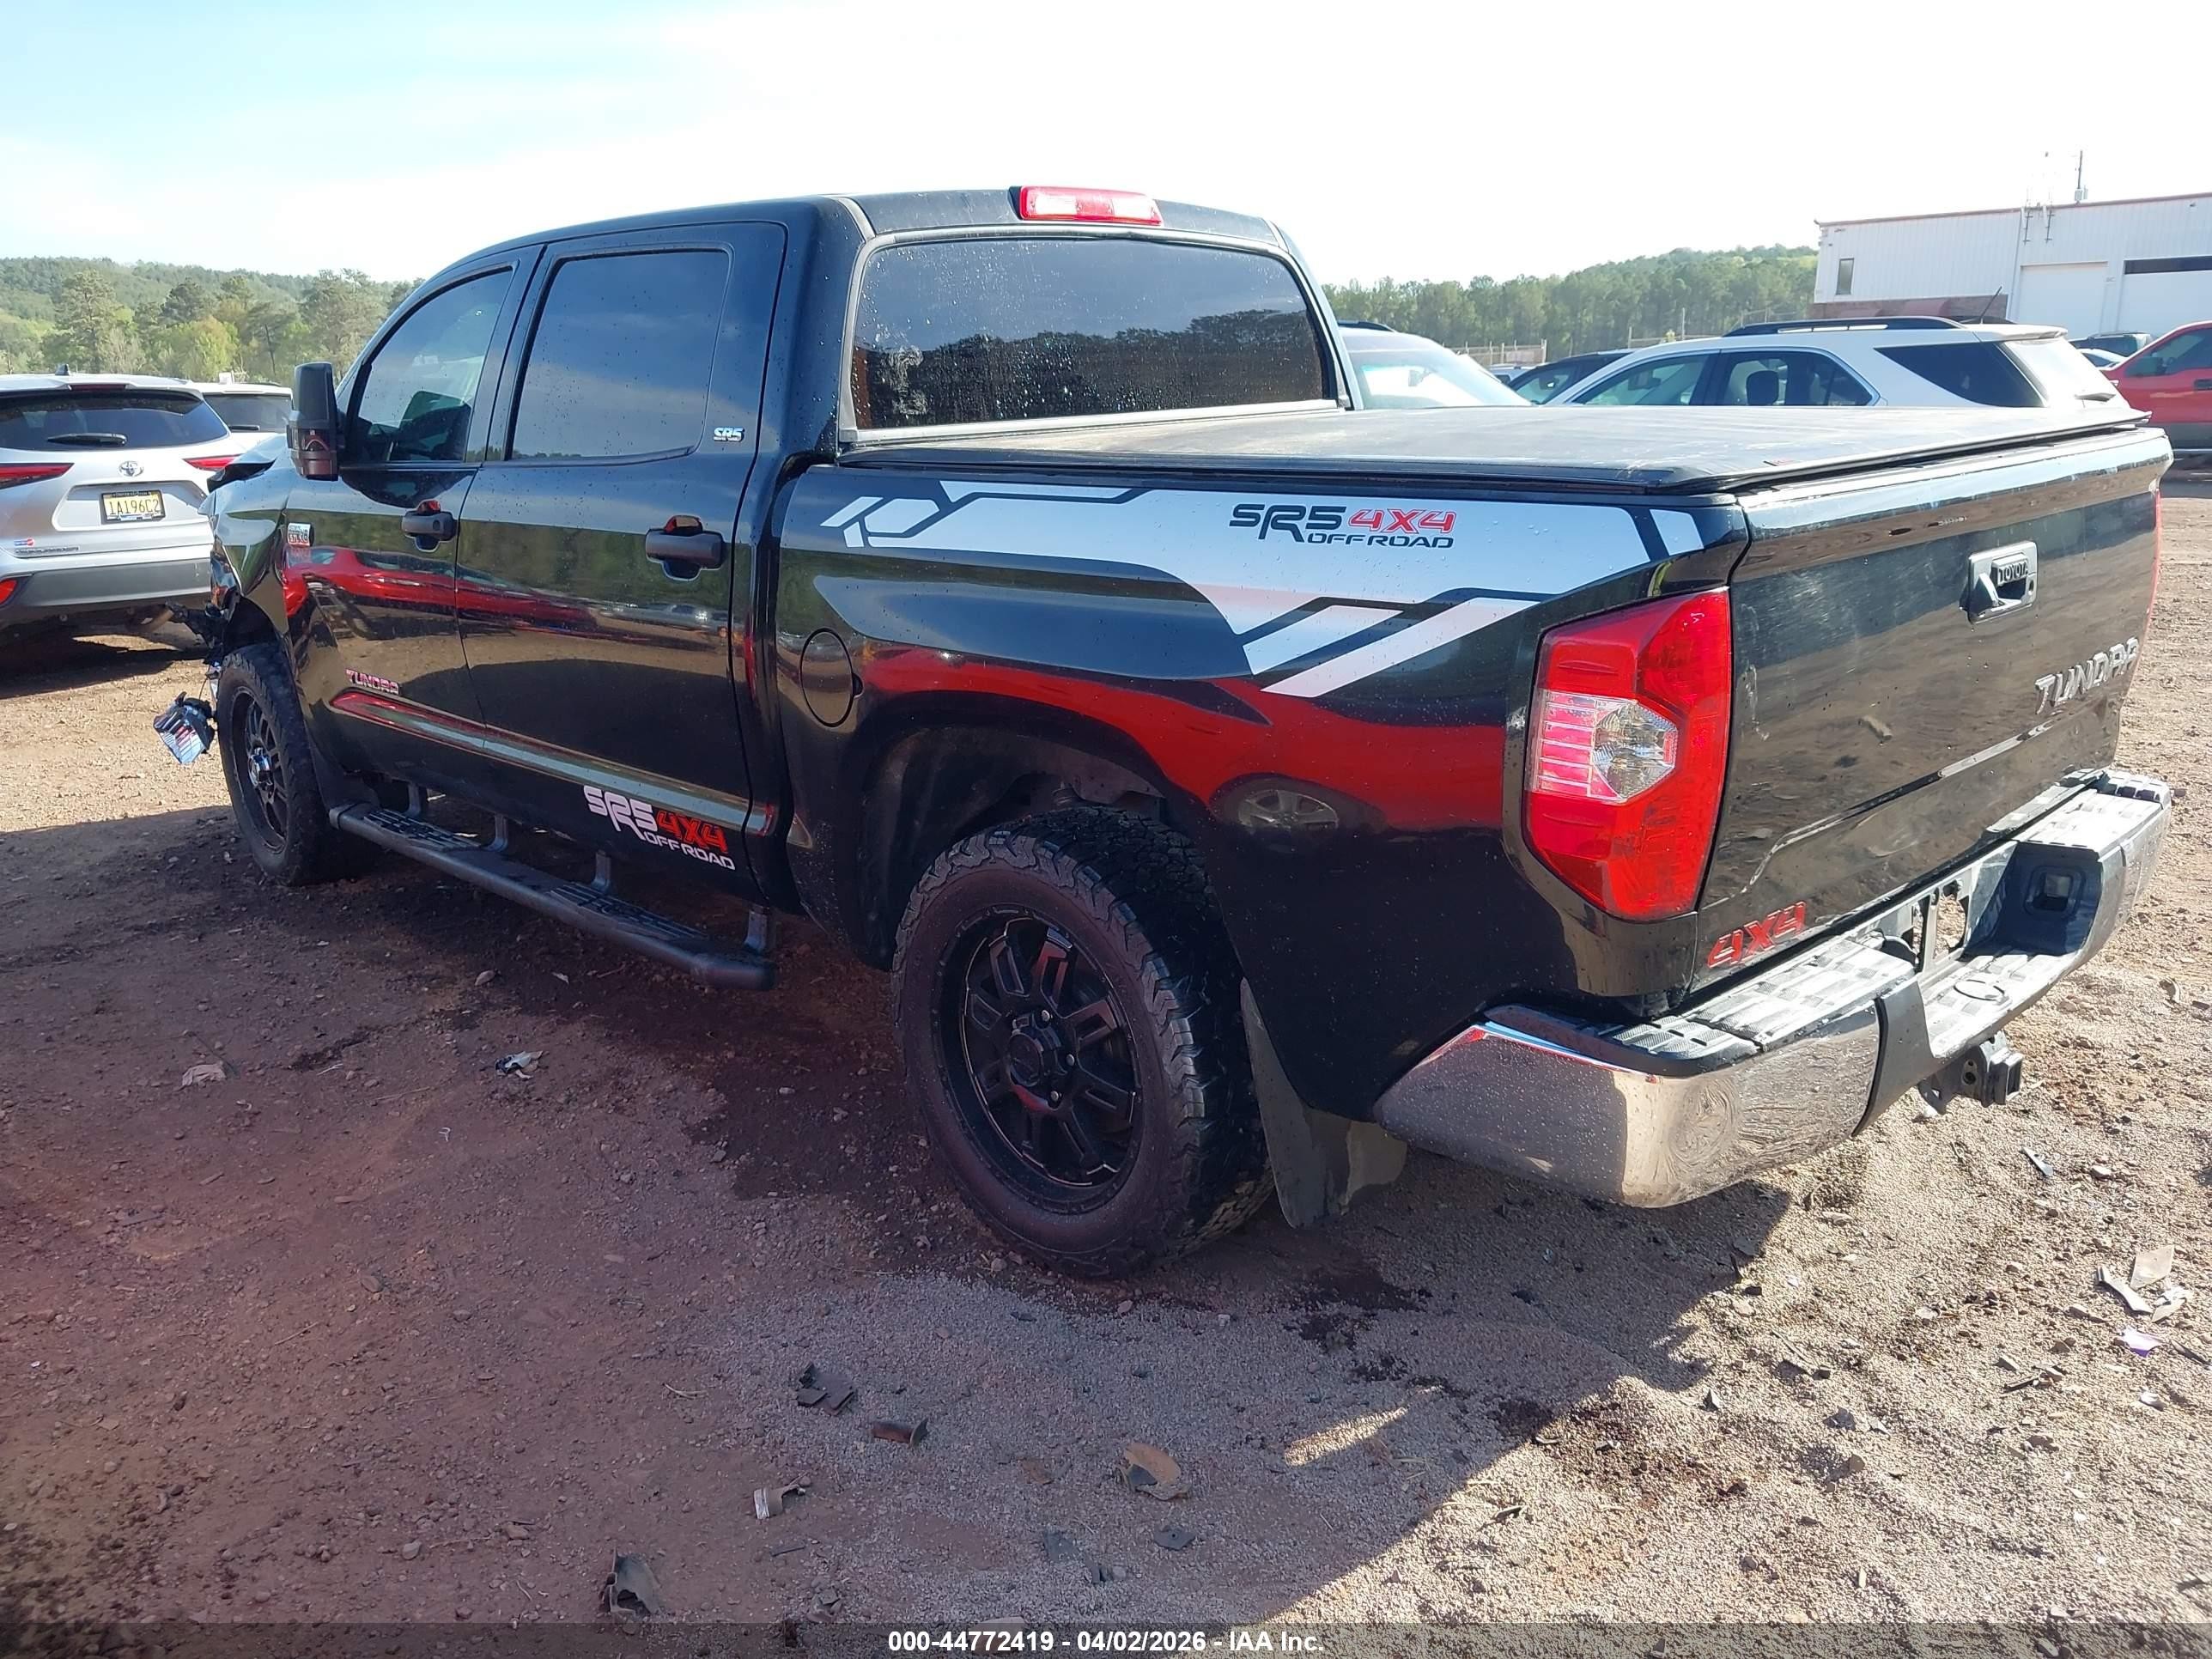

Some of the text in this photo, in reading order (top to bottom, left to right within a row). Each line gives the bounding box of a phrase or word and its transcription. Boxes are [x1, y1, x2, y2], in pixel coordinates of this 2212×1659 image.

[714, 427, 744, 441] SR5
[1229, 503, 1346, 543] SR5
[346, 669, 399, 696] TUNDRA
[584, 785, 659, 841] SR5
